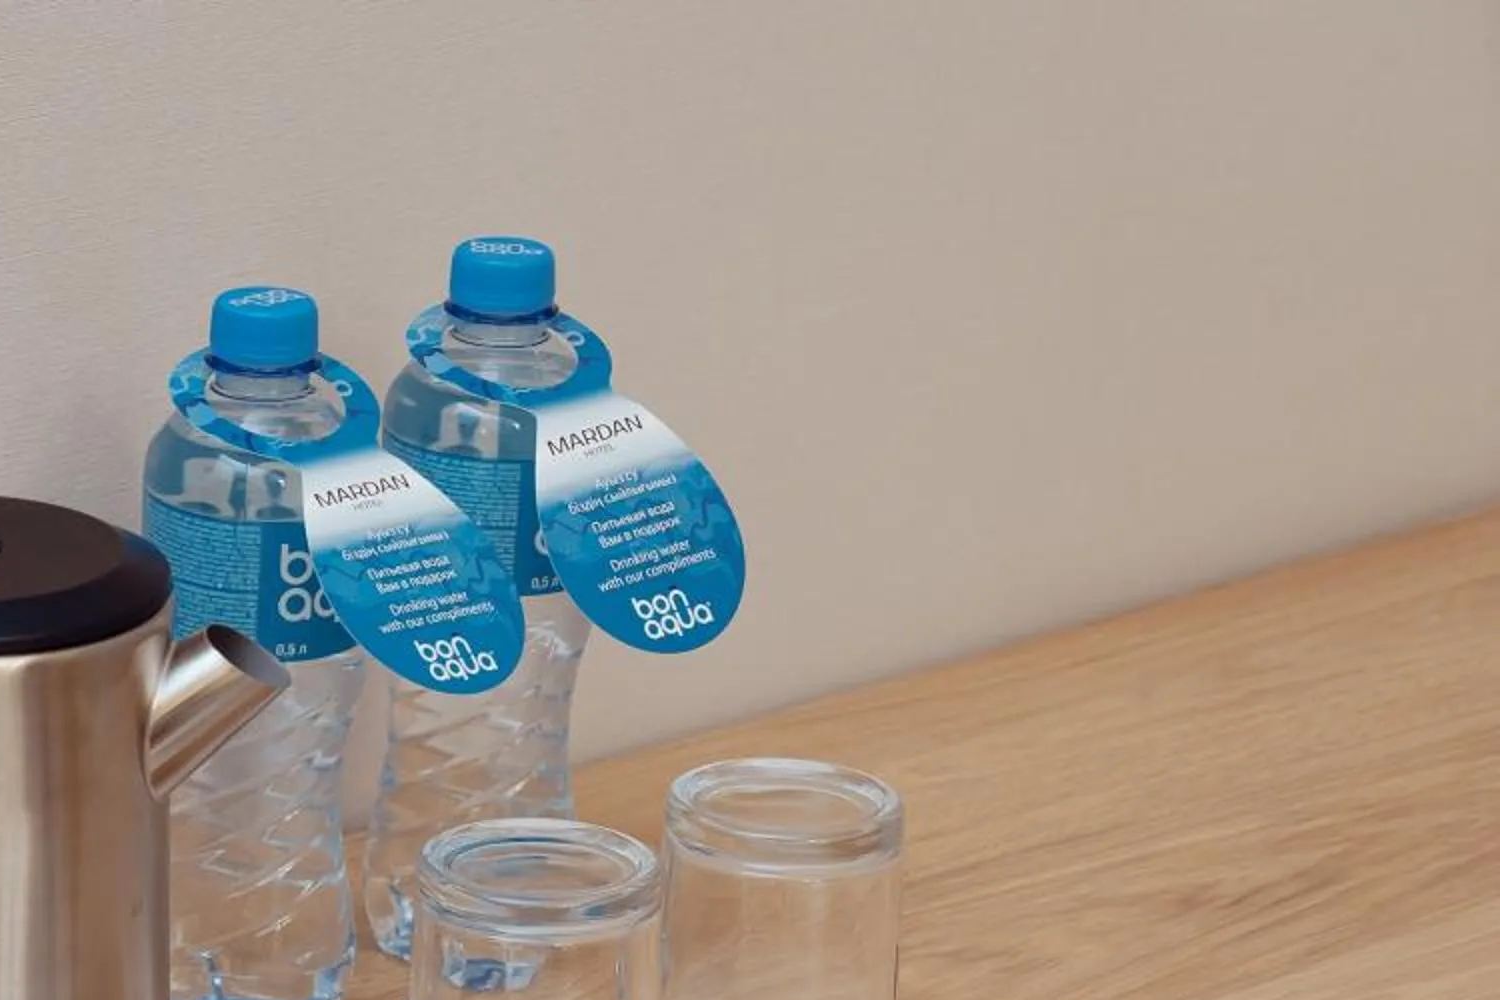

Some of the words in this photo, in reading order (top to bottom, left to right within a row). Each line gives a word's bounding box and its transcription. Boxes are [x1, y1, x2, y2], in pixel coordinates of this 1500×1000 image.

[547, 414, 643, 457] MARDAN
[313, 473, 411, 508] MARDAN
[598, 575, 625, 594] with
[626, 571, 644, 585] our
[645, 548, 716, 581] compliments
[609, 549, 659, 573] Drinking
[660, 539, 690, 559] water
[379, 617, 404, 634] with
[406, 615, 426, 629] our
[427, 600, 495, 627] compliments
[388, 597, 440, 617] Drinking
[440, 591, 468, 607] water
[631, 588, 688, 620] bon
[644, 603, 714, 640] aqua
[413, 635, 472, 663] bon
[430, 651, 498, 681] aqua
